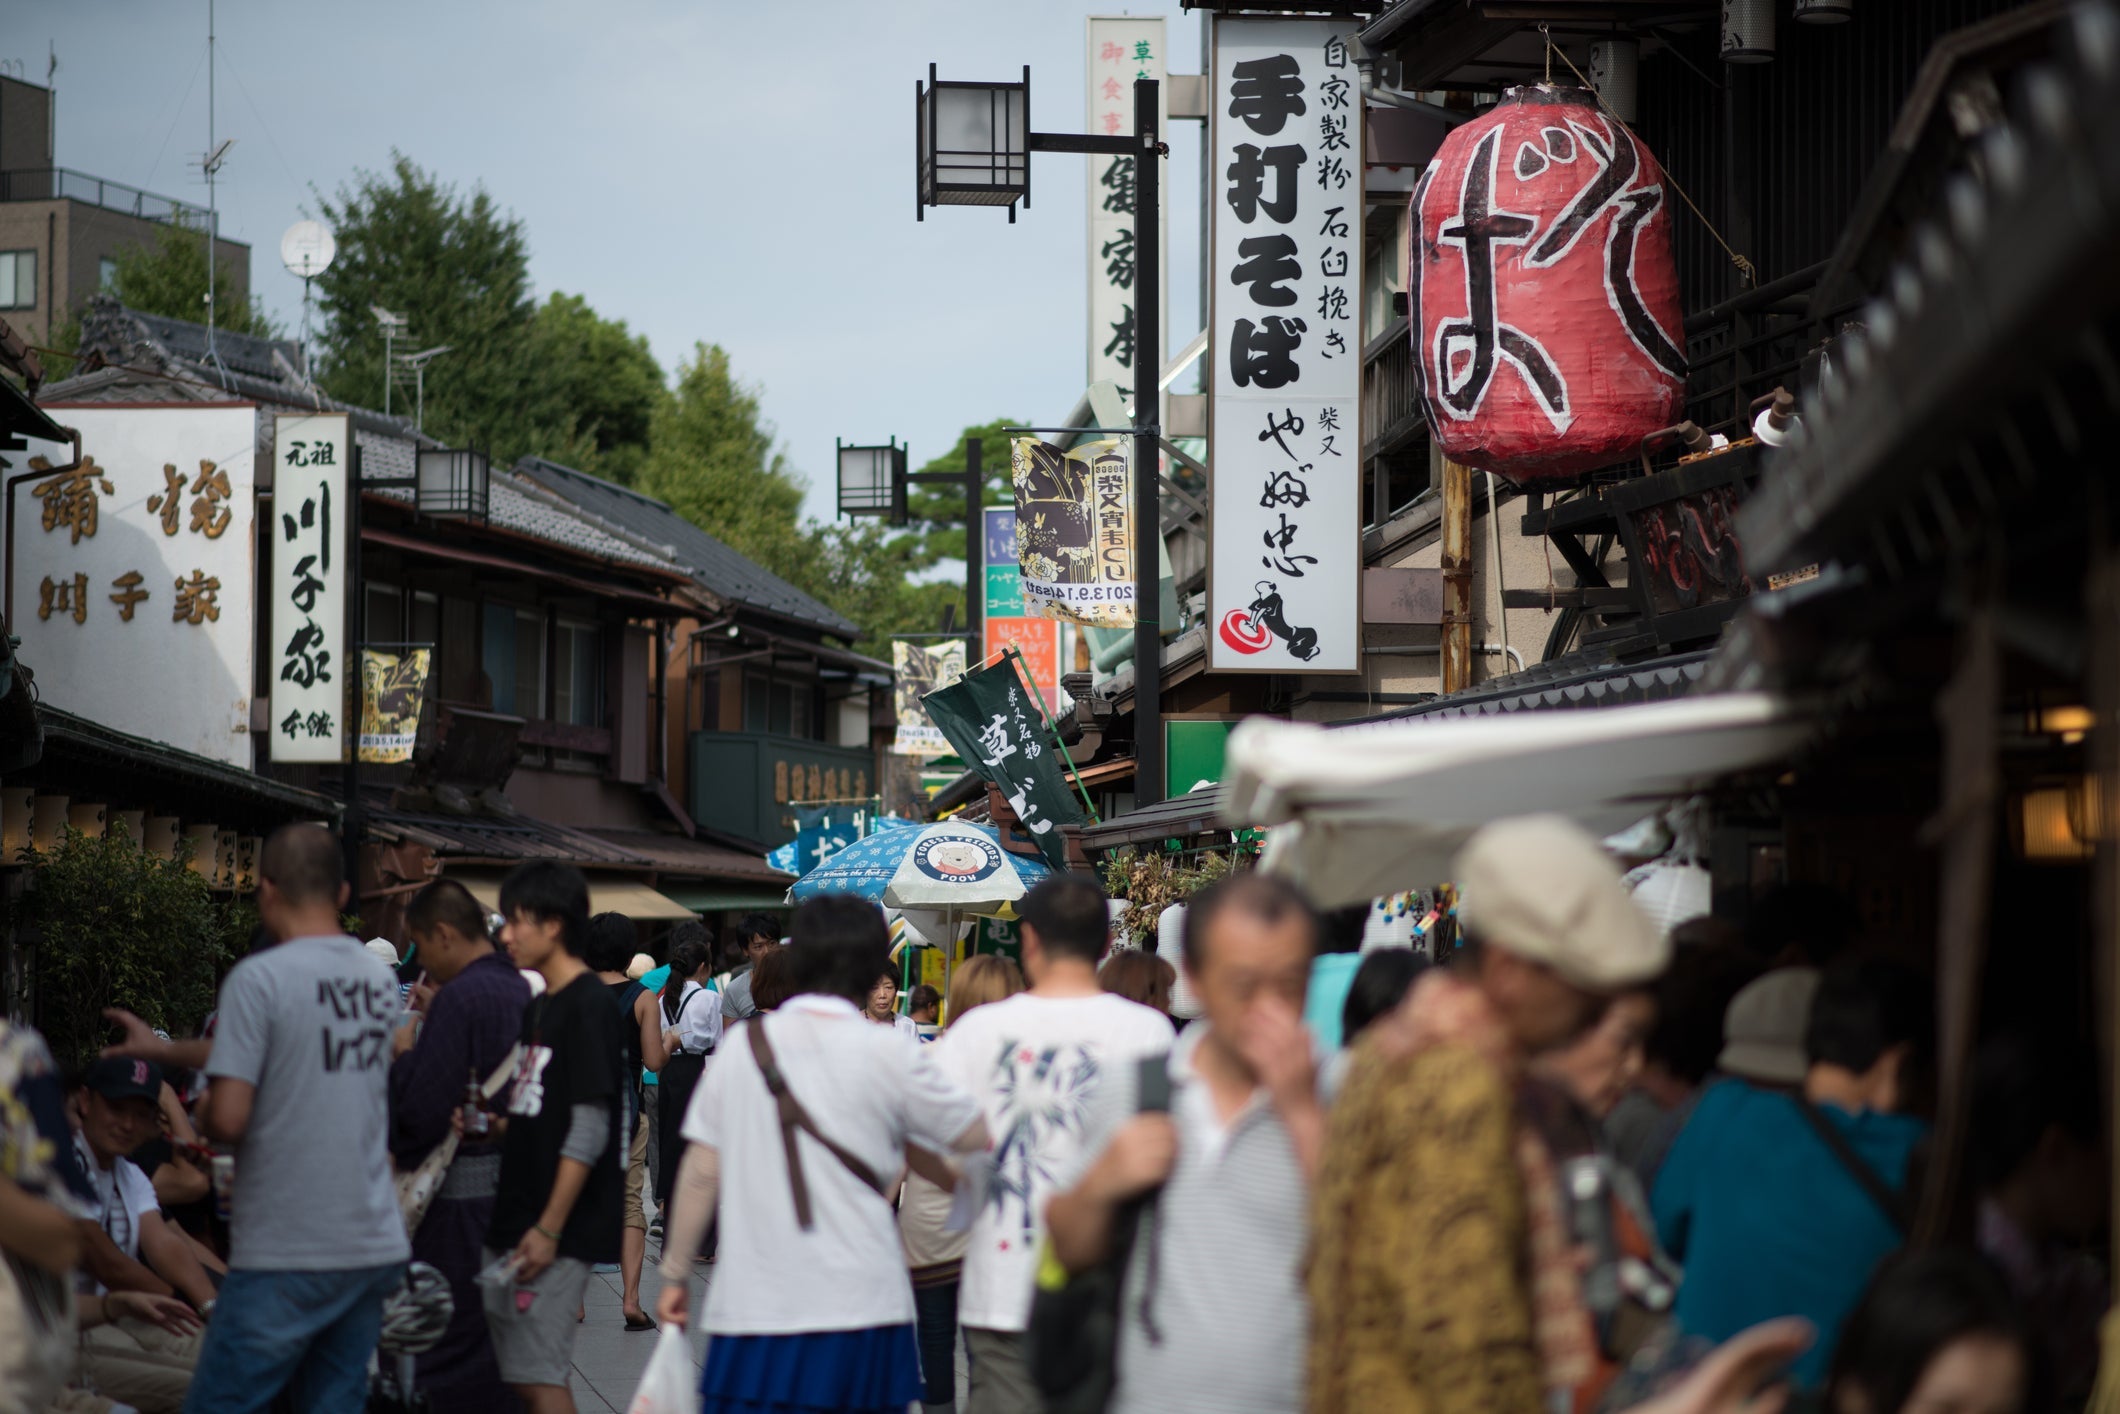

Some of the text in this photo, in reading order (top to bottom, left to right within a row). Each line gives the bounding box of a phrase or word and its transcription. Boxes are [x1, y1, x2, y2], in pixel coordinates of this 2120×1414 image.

[1227, 54, 1308, 389] 手打そば
[1317, 35, 1351, 359] 自家製粉 石臼挽き
[285, 441, 336, 467] 元祖
[1318, 407, 1342, 456] 柴又
[38, 569, 221, 625] 川千家
[281, 480, 331, 689] 川千家
[1008, 686, 1042, 760] 柴又名物
[917, 836, 999, 860] FOREST FRIENDS
[941, 873, 976, 882] POOH
